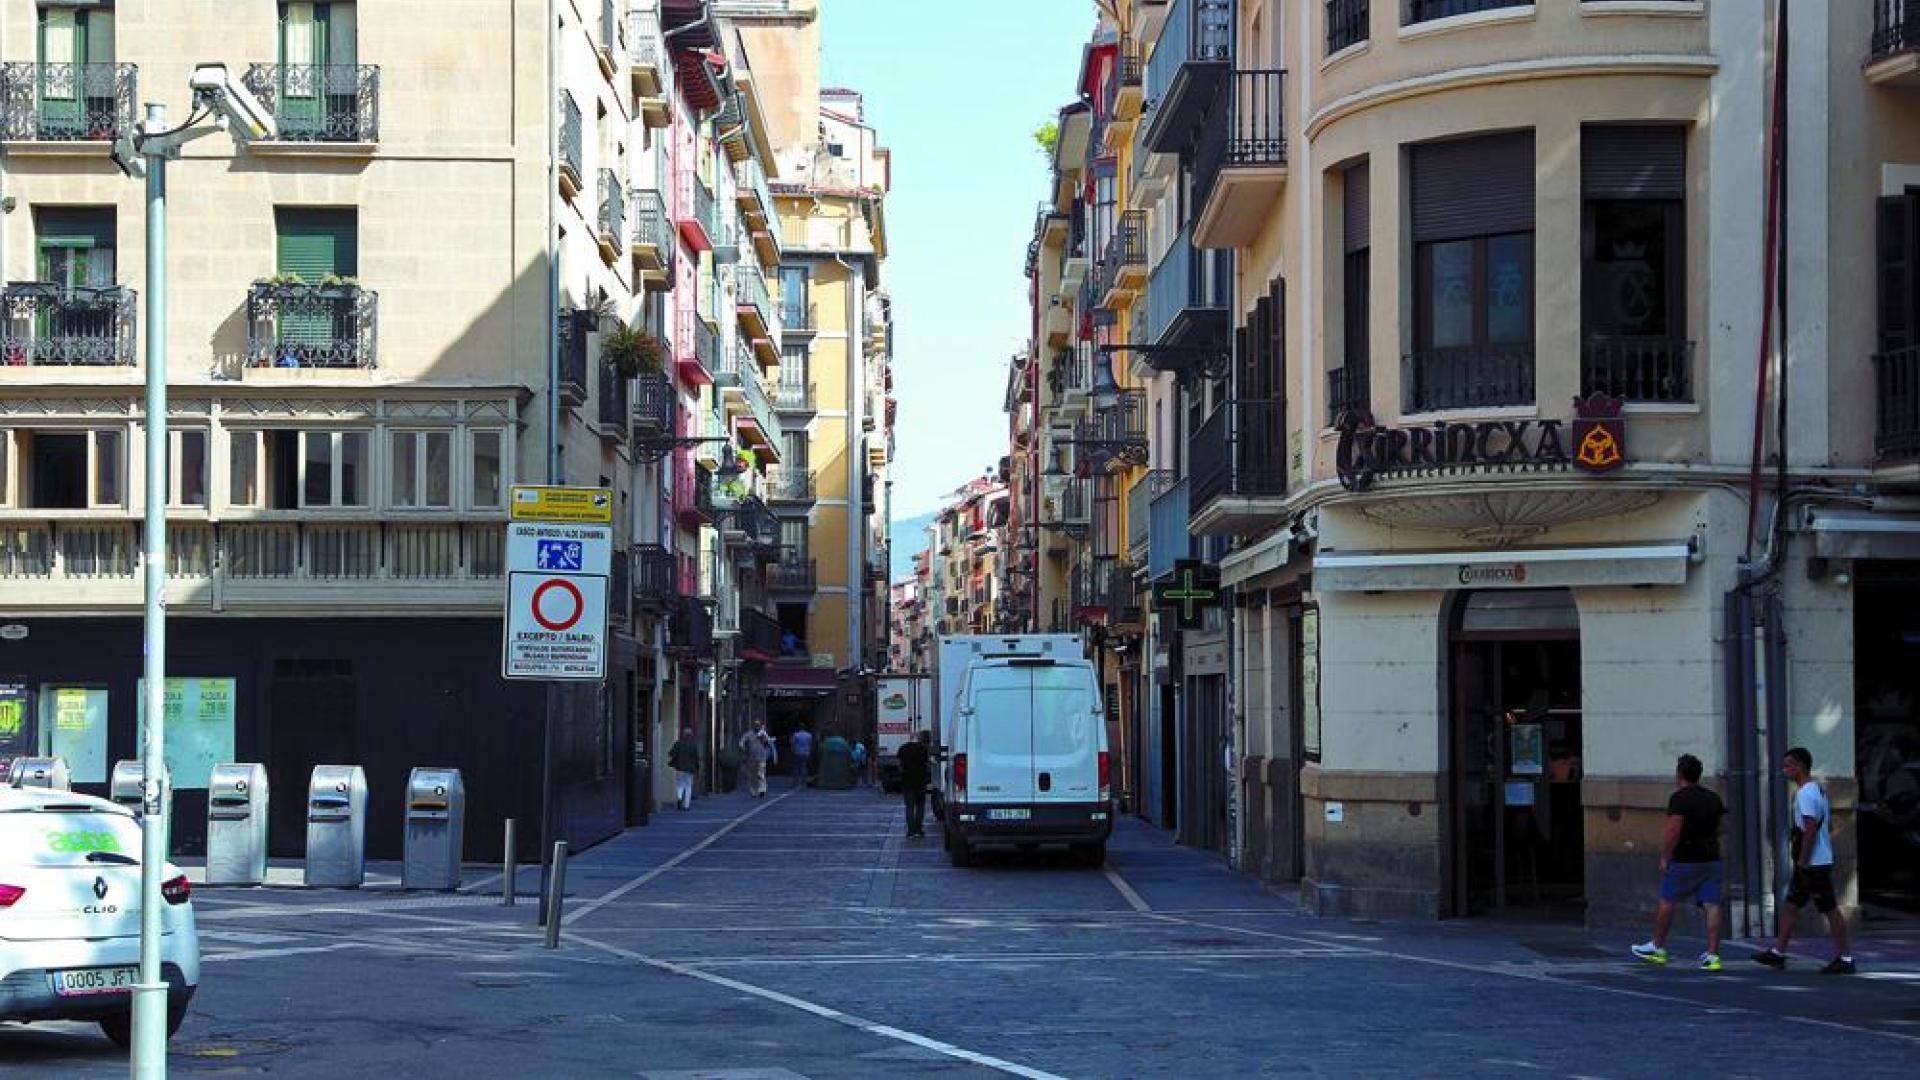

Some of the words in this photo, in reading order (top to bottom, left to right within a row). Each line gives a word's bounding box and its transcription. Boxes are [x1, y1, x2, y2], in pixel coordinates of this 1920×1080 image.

[517, 632, 557, 640] EXCEPTO
[83, 905, 117, 914] CLIO
[66, 972, 104, 988] 0005
